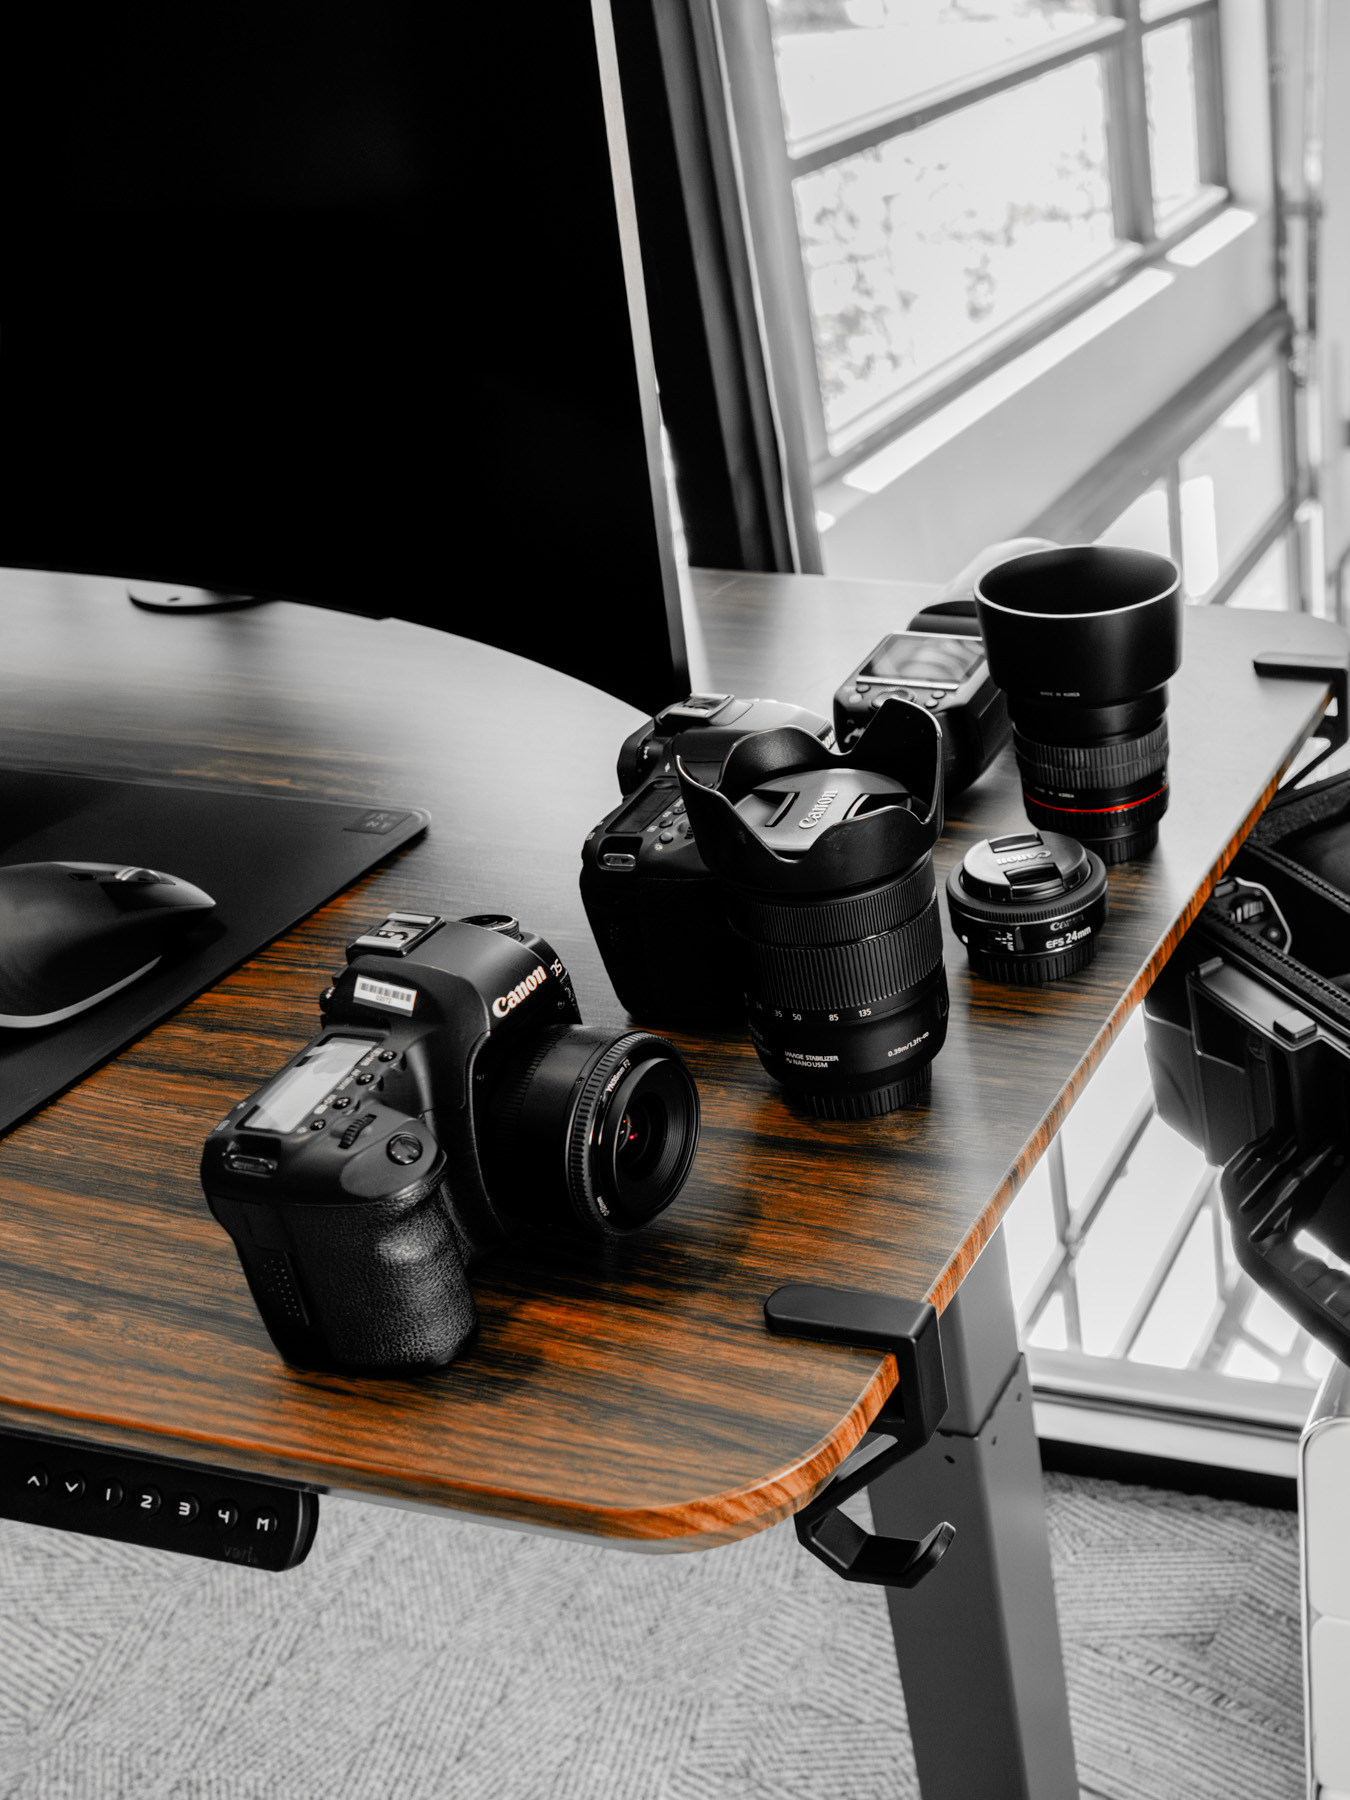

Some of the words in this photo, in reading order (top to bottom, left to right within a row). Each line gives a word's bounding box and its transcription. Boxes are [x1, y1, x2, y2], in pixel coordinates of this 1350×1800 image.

[799, 790, 838, 829] Canon
[996, 851, 1052, 866] Canon
[1050, 914, 1084, 931] Can
[1045, 937, 1065, 949] EFS
[1065, 926, 1092, 944] 24mm
[550, 958, 564, 977] OS
[492, 965, 547, 1018] Canon
[774, 1010, 783, 1018] 35
[792, 1013, 802, 1021] 50
[828, 1013, 839, 1022] 85
[858, 1008, 872, 1018] 135
[784, 1051, 804, 1059] IMAGE
[106, 1488, 111, 1501] 1
[140, 1494, 153, 1509] 2
[178, 1501, 191, 1516] 3
[218, 1509, 230, 1524] 4
[256, 1517, 270, 1532] M
